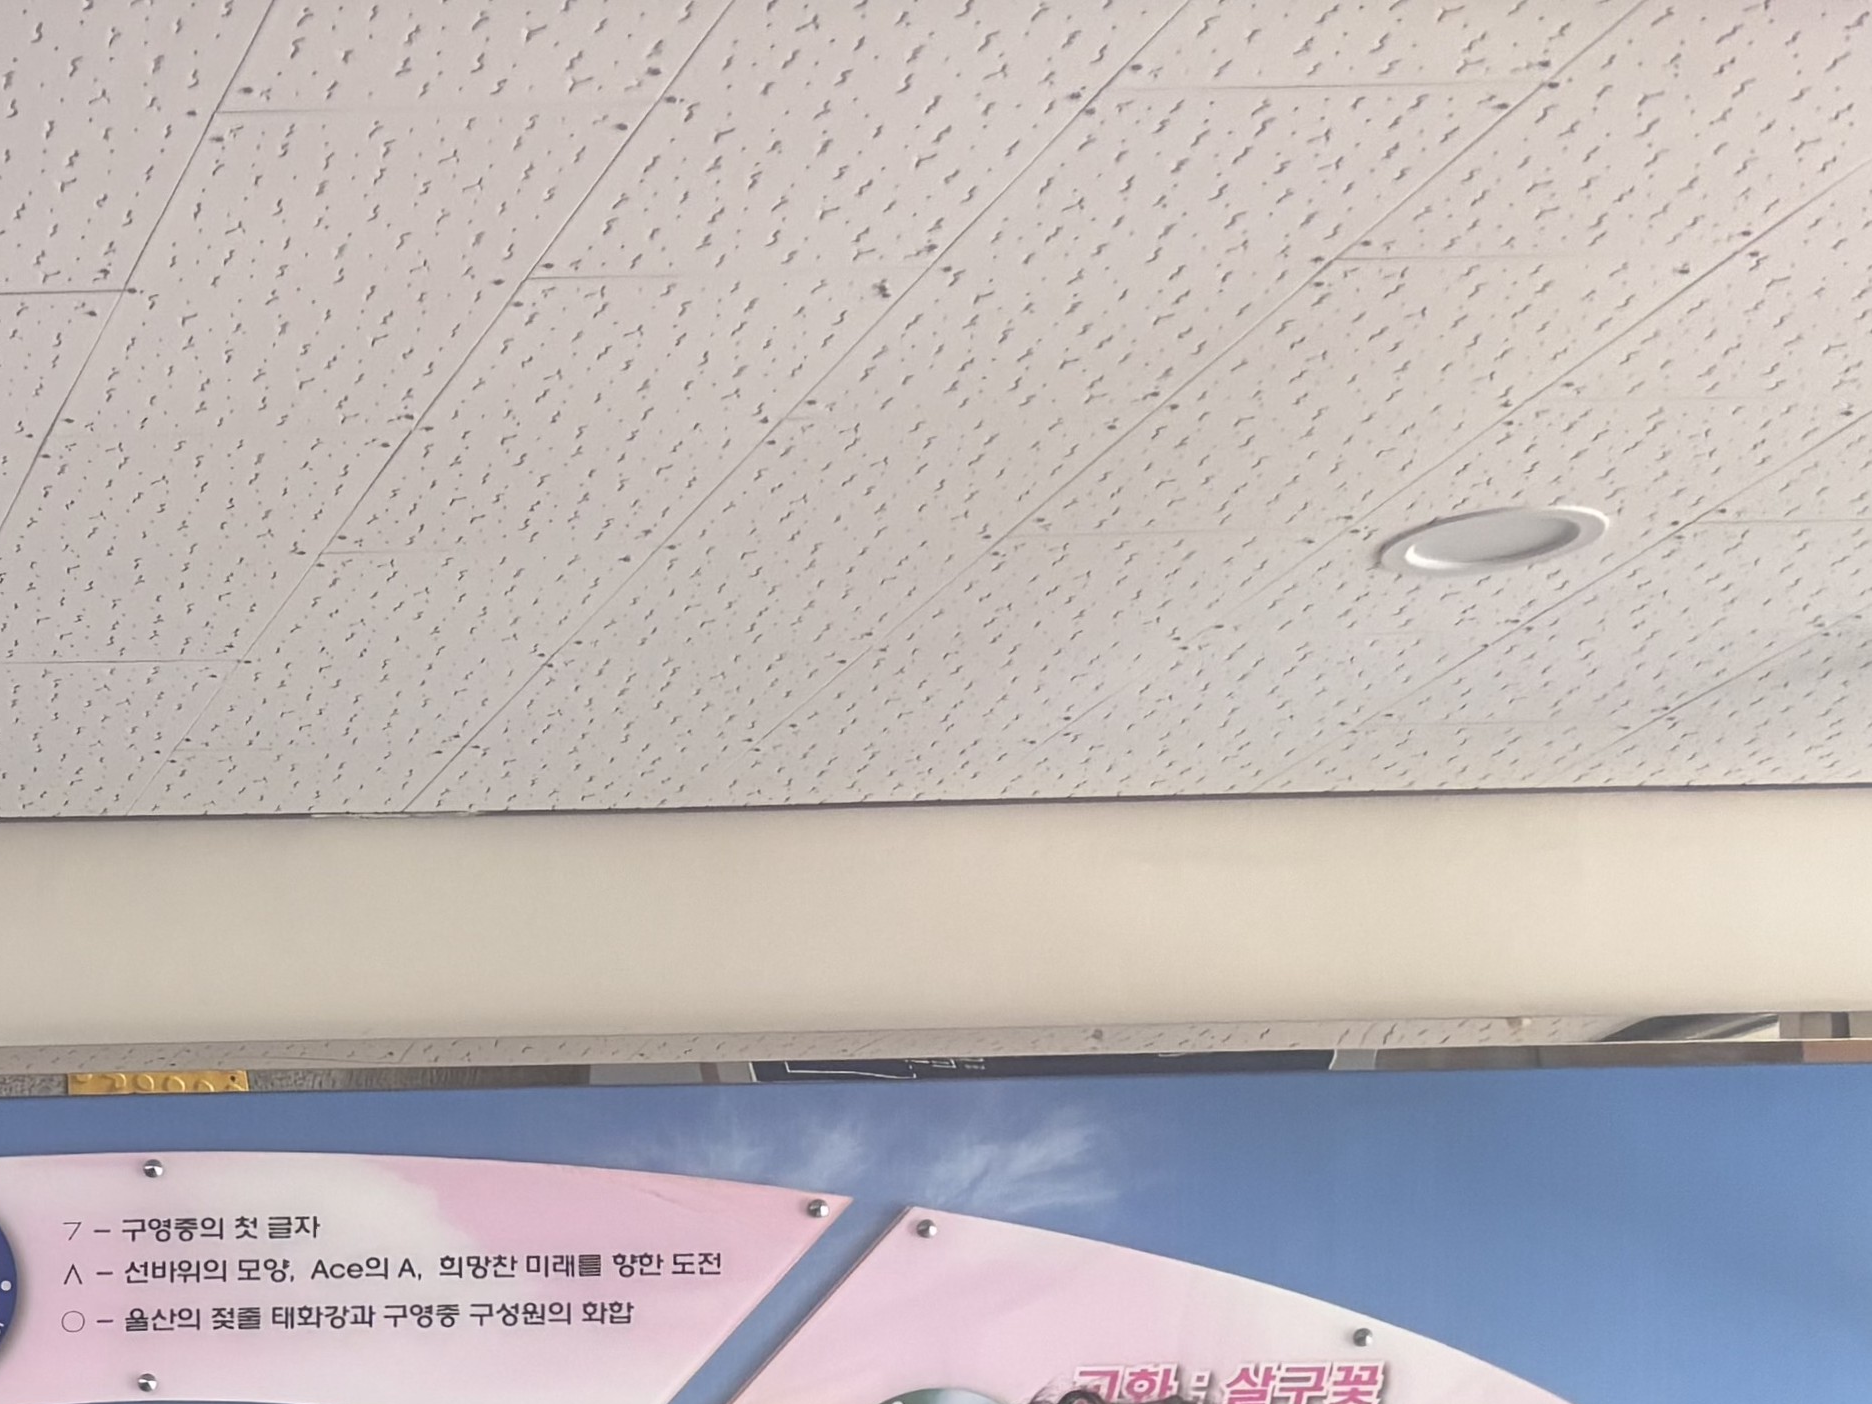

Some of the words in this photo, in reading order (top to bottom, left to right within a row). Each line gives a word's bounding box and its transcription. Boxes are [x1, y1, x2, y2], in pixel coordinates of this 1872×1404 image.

[122, 1217, 224, 1242] 구영중의
[234, 1216, 258, 1240] 첫
[267, 1215, 321, 1239] 글자
[124, 1259, 227, 1284] 선바위의
[237, 1258, 295, 1283] 모양,
[310, 1256, 389, 1281] Ace의
[398, 1257, 422, 1281] A,
[439, 1253, 518, 1279] 희망찬
[526, 1254, 602, 1278] 미래를
[612, 1252, 664, 1278] 향한
[671, 1252, 722, 1276] 도전
[124, 1308, 201, 1332] 울산의
[210, 1306, 262, 1331] 젖줄
[271, 1304, 376, 1330] 태화강과
[384, 1302, 460, 1328] 구영중
[469, 1301, 572, 1327] 구성원의
[581, 1300, 635, 1325] 화합
